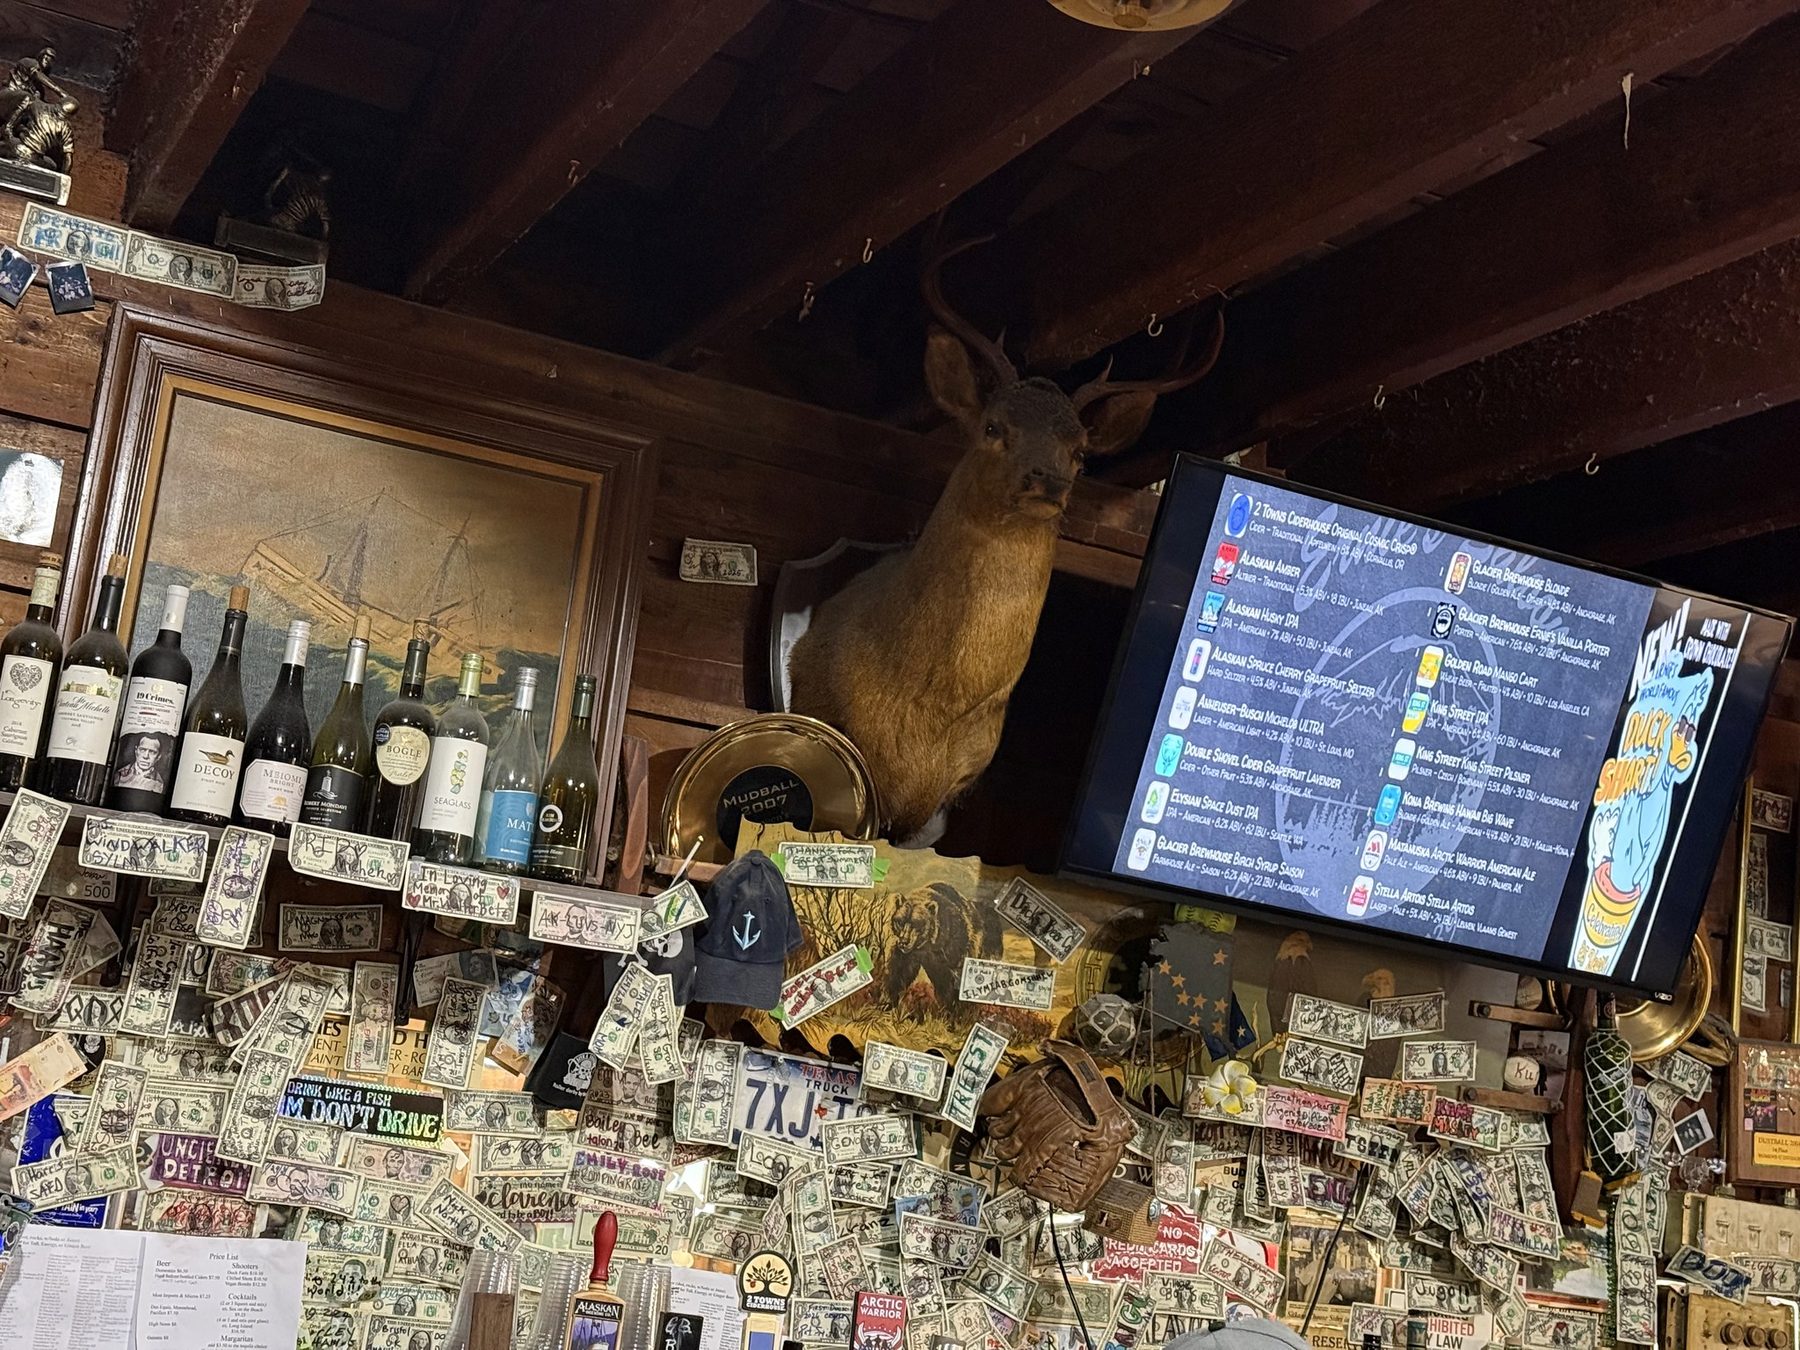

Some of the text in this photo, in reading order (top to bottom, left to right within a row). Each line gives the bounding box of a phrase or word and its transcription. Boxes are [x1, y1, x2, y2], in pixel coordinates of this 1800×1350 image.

[1253, 502, 1262, 516] 2
[1239, 550, 1276, 571] ALASKAN
[1225, 599, 1262, 620] ALASKAN
[1284, 613, 1301, 629] IPA
[1211, 647, 1248, 667] ALASKAN
[1630, 598, 1691, 701] NEW!
[1472, 661, 1495, 678] ROAD
[1518, 672, 1539, 688] CART
[136, 691, 145, 700] 19
[1298, 718, 1326, 736] ULTRA
[1475, 711, 1490, 726] IPA
[1622, 709, 1673, 758] DUCK
[386, 745, 422, 758] BOGLE
[193, 763, 236, 780] DECOY
[722, 779, 800, 808] MUDBALL
[433, 796, 472, 810] SEAGLASS
[741, 794, 788, 815] 2007
[1244, 805, 1260, 820] IPA
[506, 817, 535, 833] MAT
[420, 866, 488, 894] In Loving
[799, 863, 851, 881] TROY
[1522, 868, 1537, 881] ALE
[84, 886, 111, 899] 500
[1374, 883, 1401, 900] STELLA
[1426, 894, 1452, 910] STELLA
[1654, 992, 1673, 1001] VIZIO
[801, 1064, 857, 1087] TEXAS
[287, 1081, 392, 1107] DRINK LIKE A FISH
[805, 1079, 850, 1096] TRUCK
[745, 1078, 815, 1139] 7XJ
[310, 1099, 440, 1138] DON'T DRIVE
[585, 1113, 626, 1135] Bailey
[163, 1158, 250, 1188] DETROI
[1163, 1224, 1183, 1240] NO
[209, 1252, 239, 1261] Price List
[1153, 1241, 1200, 1259] CARDS
[231, 1262, 259, 1271] Shooters
[1111, 1255, 1183, 1273] ACCEPTED
[228, 1292, 257, 1301] Cocktails
[746, 1295, 786, 1306] 2 TOWNS
[860, 1296, 904, 1311] ARCTIC
[575, 1301, 621, 1319] ALASKAN
[860, 1306, 902, 1320] WARRIOR
[220, 1335, 254, 1344] Margaritas
[1436, 1333, 1464, 1350] LAW
